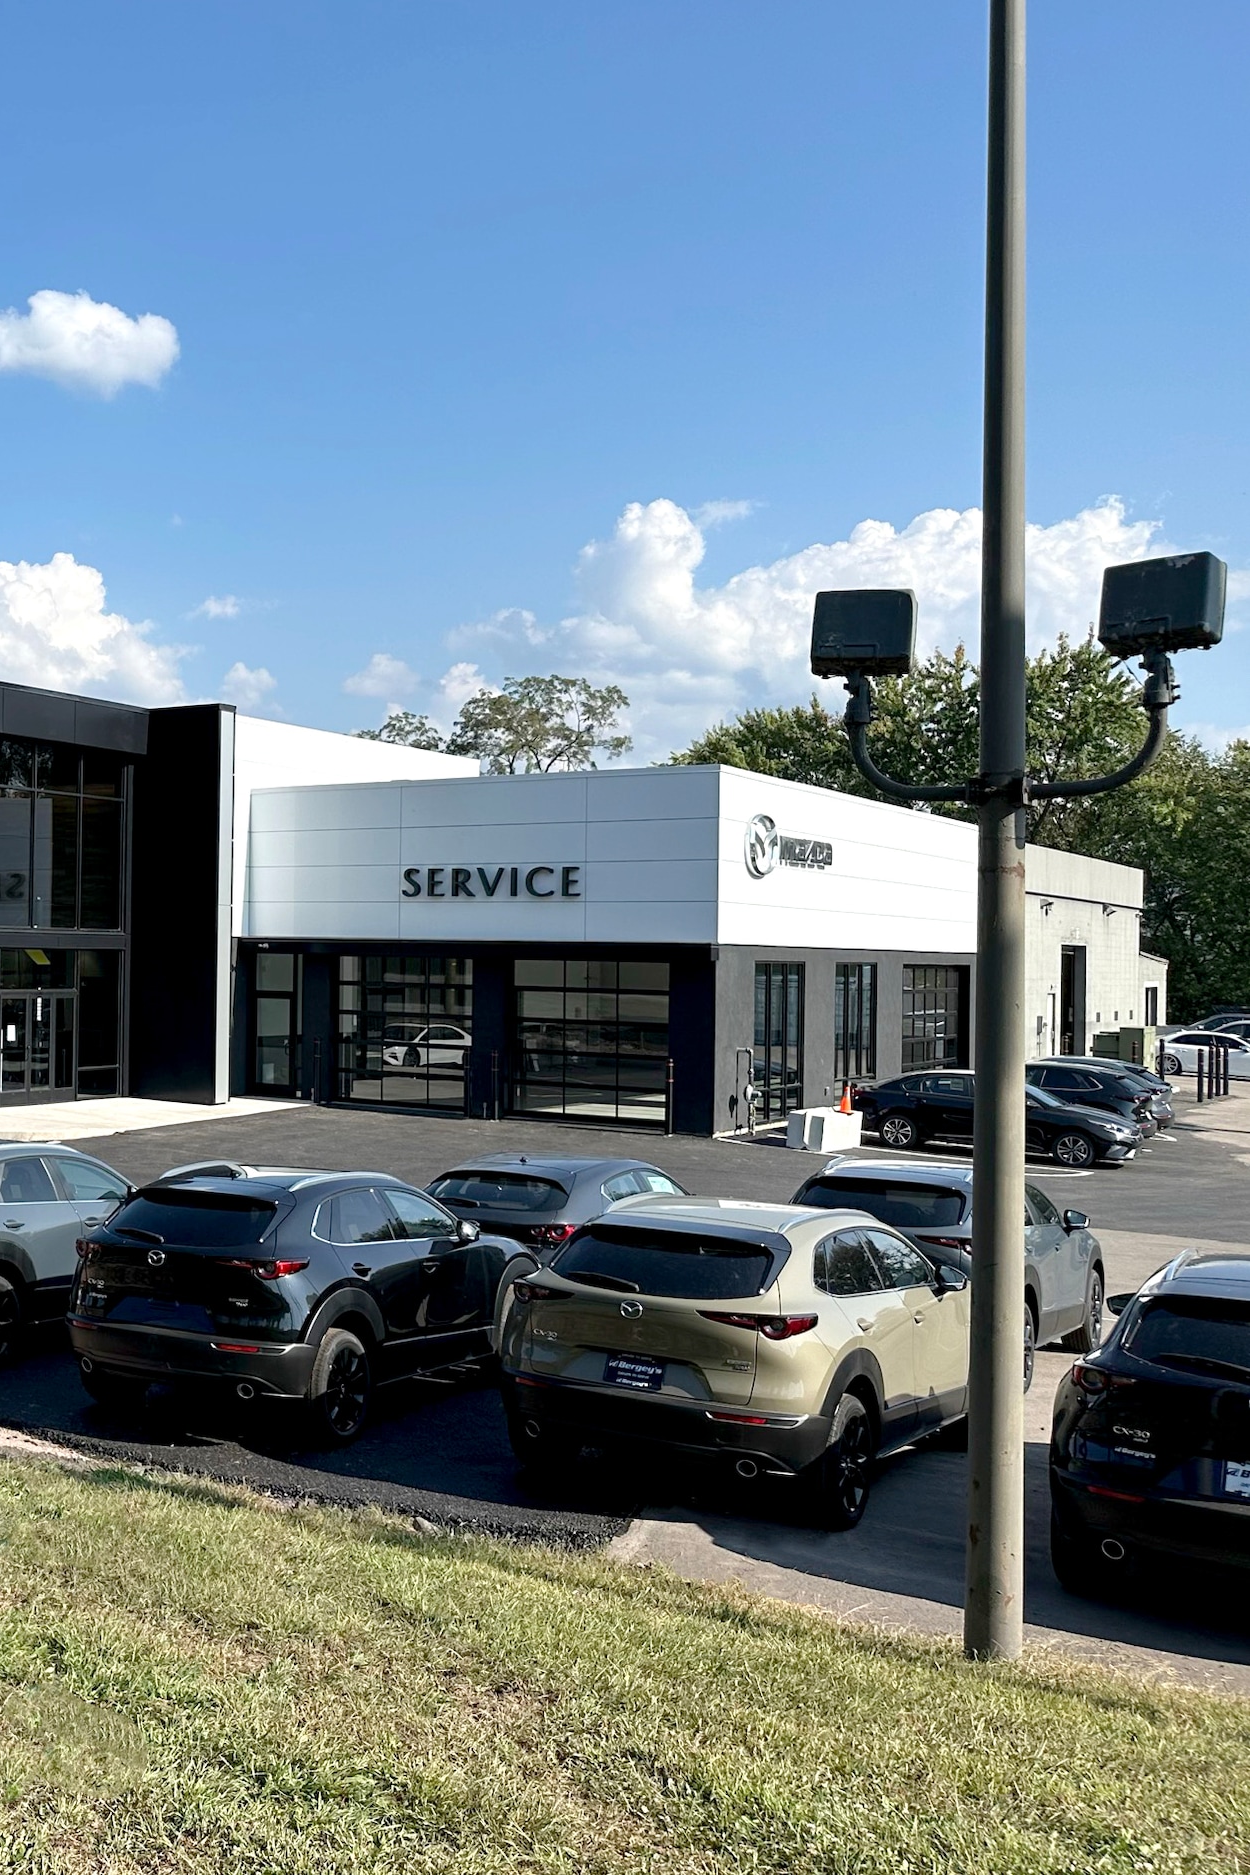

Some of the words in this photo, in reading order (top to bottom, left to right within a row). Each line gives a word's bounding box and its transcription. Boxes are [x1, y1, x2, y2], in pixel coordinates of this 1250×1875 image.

[402, 866, 581, 898] SERVICE
[618, 1360, 662, 1375] Bergey's
[1113, 1425, 1150, 1439] CX-30
